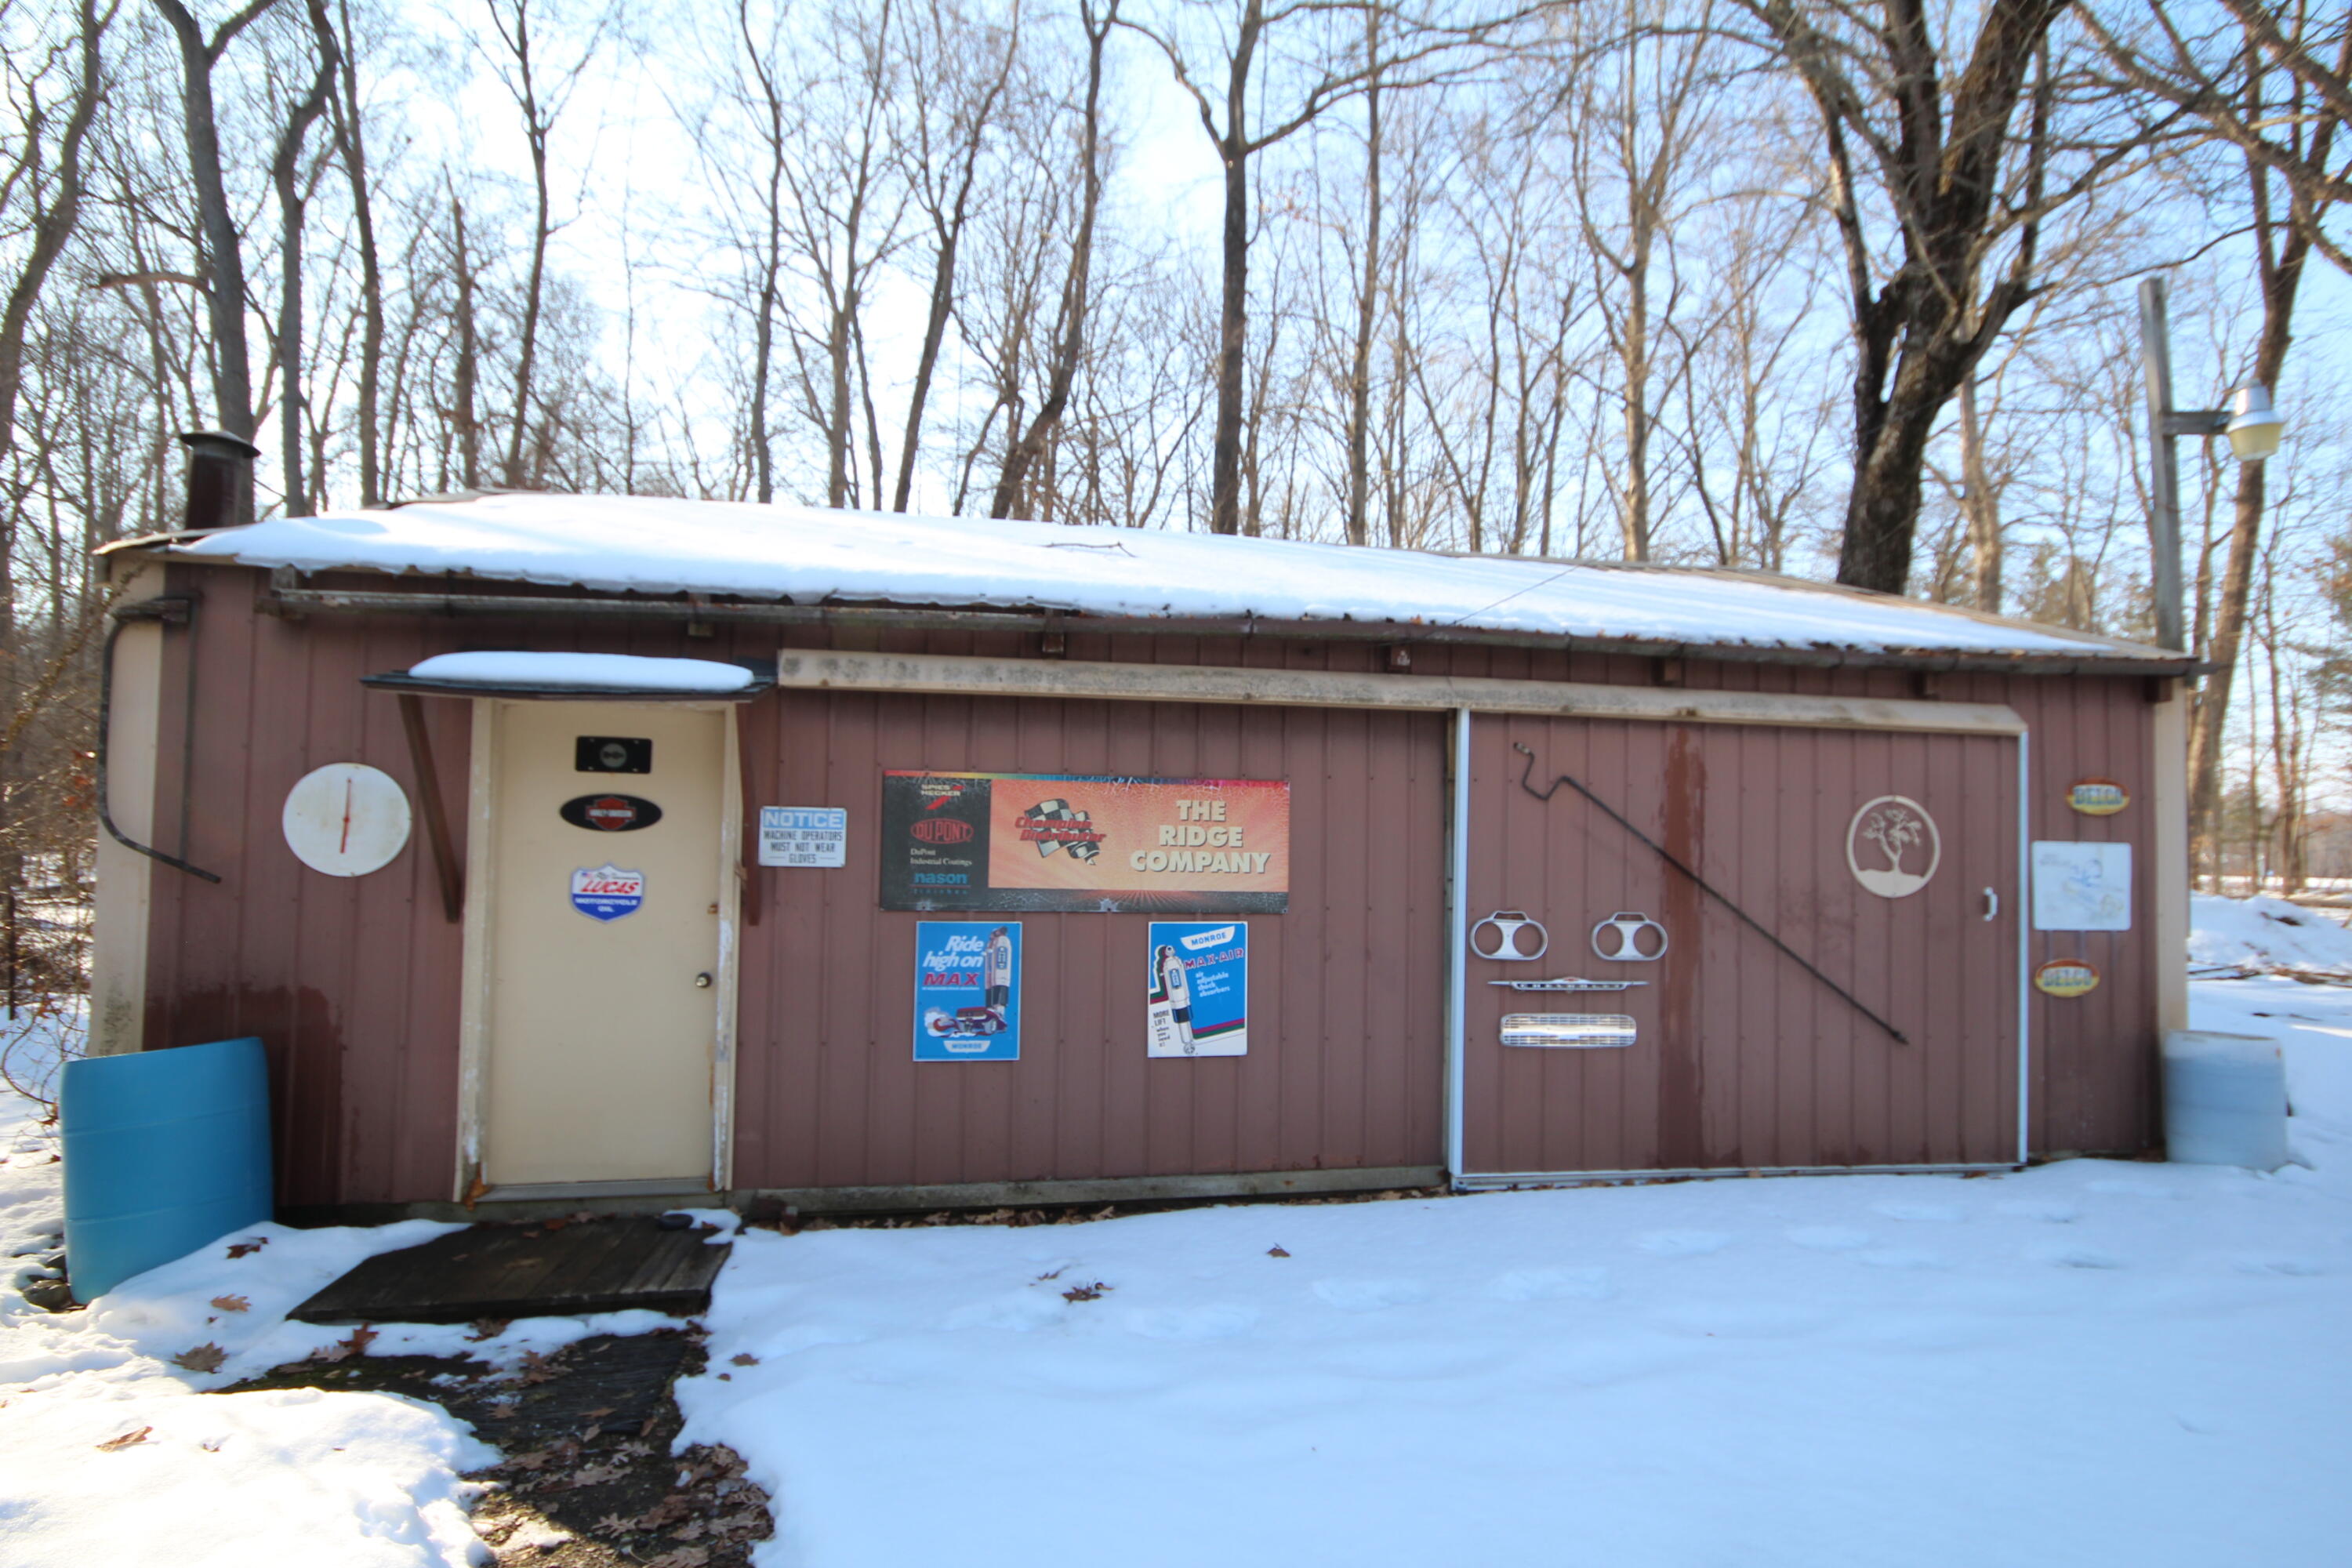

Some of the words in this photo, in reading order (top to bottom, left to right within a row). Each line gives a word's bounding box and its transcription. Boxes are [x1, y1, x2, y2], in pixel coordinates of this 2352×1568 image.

[1177, 800, 1226, 822] THE
[764, 811, 842, 827] NOTICE
[1014, 817, 1092, 829] Champion
[764, 831, 797, 840] MACHINE
[801, 831, 842, 841] OPERATORS
[1020, 829, 1107, 842] Distributor
[1160, 825, 1243, 847] RIDGE
[771, 842, 790, 852] MUST
[795, 843, 809, 852] NOT
[815, 843, 835, 853] WEAR
[789, 854, 816, 864] GLOVES
[942, 858, 972, 866] Coatings
[1131, 850, 1271, 873] COMPANY
[915, 873, 967, 884] nason
[580, 880, 640, 894] LUCAS
[945, 935, 984, 952] Ride
[1191, 932, 1227, 946] MONROE
[922, 951, 960, 971] high
[960, 956, 984, 967] on
[923, 972, 979, 985] MAX
[1196, 972, 1229, 985] adjustable
[1197, 982, 1216, 991] shock
[1199, 986, 1230, 997] absorbers
